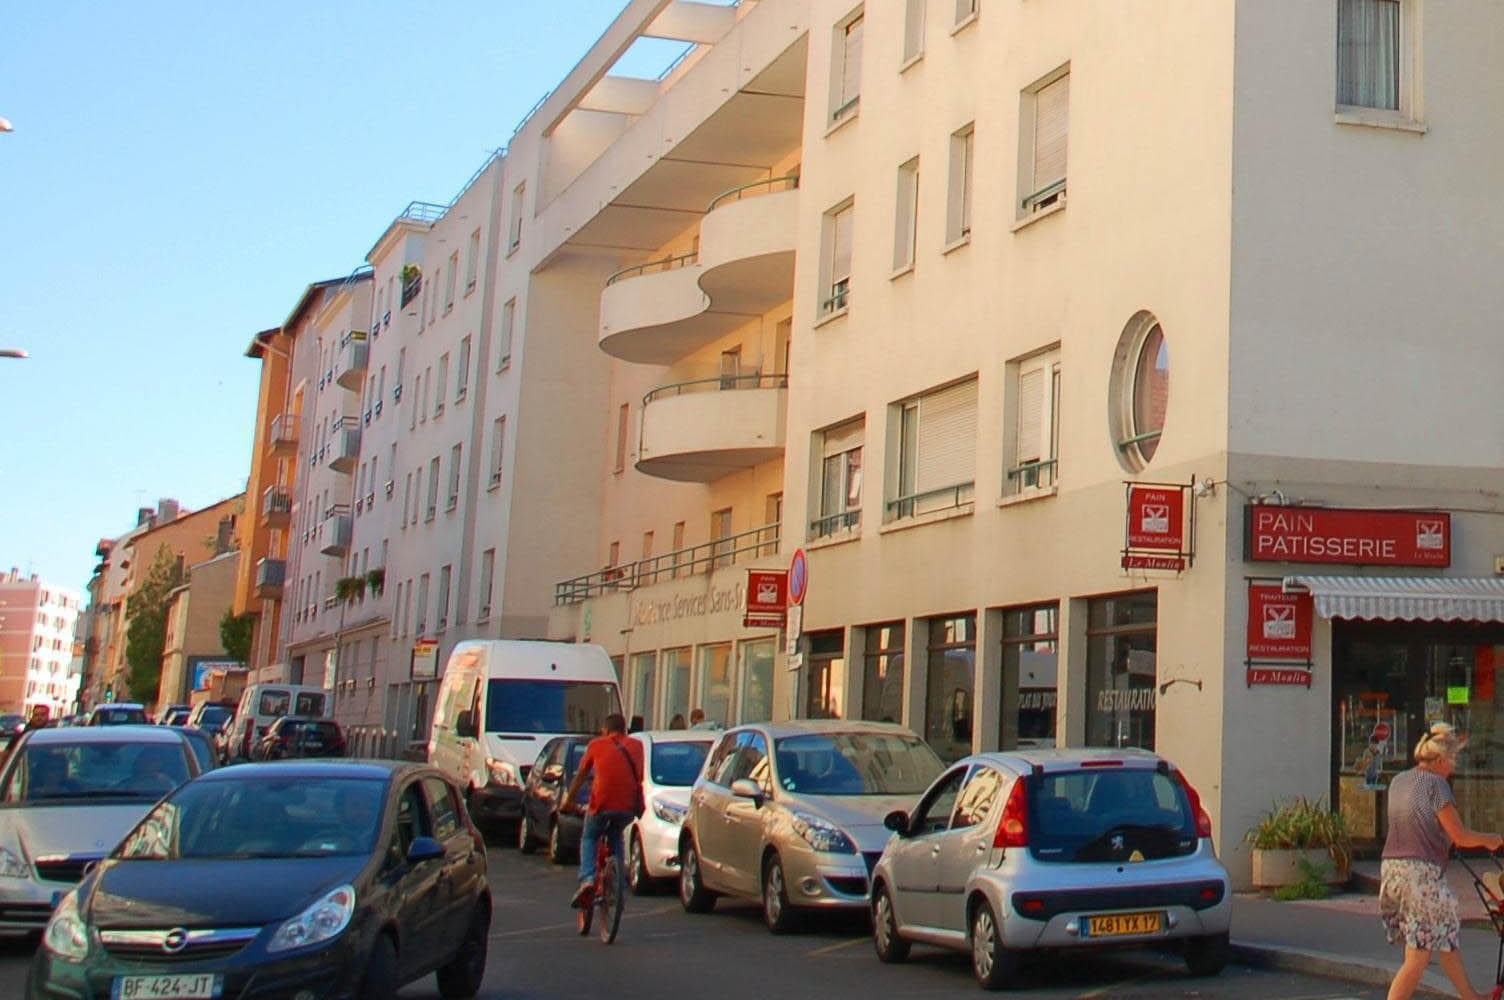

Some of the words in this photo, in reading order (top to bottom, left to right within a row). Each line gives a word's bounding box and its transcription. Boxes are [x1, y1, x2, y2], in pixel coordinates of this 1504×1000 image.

[1145, 493, 1166, 502] PAIN
[1258, 513, 1313, 532] PAIN
[1258, 536, 1396, 558] PATISSERIE
[1128, 558, 1141, 567] Le
[1144, 559, 1180, 569] Moulin
[674, 591, 706, 619] Services
[1253, 671, 1267, 682] Le
[1270, 671, 1308, 683] Moulin
[1097, 687, 1157, 712] RESTAURATIO
[1091, 917, 1121, 932] 1481
[1123, 916, 1140, 931] YX
[1143, 915, 1157, 930] 17
